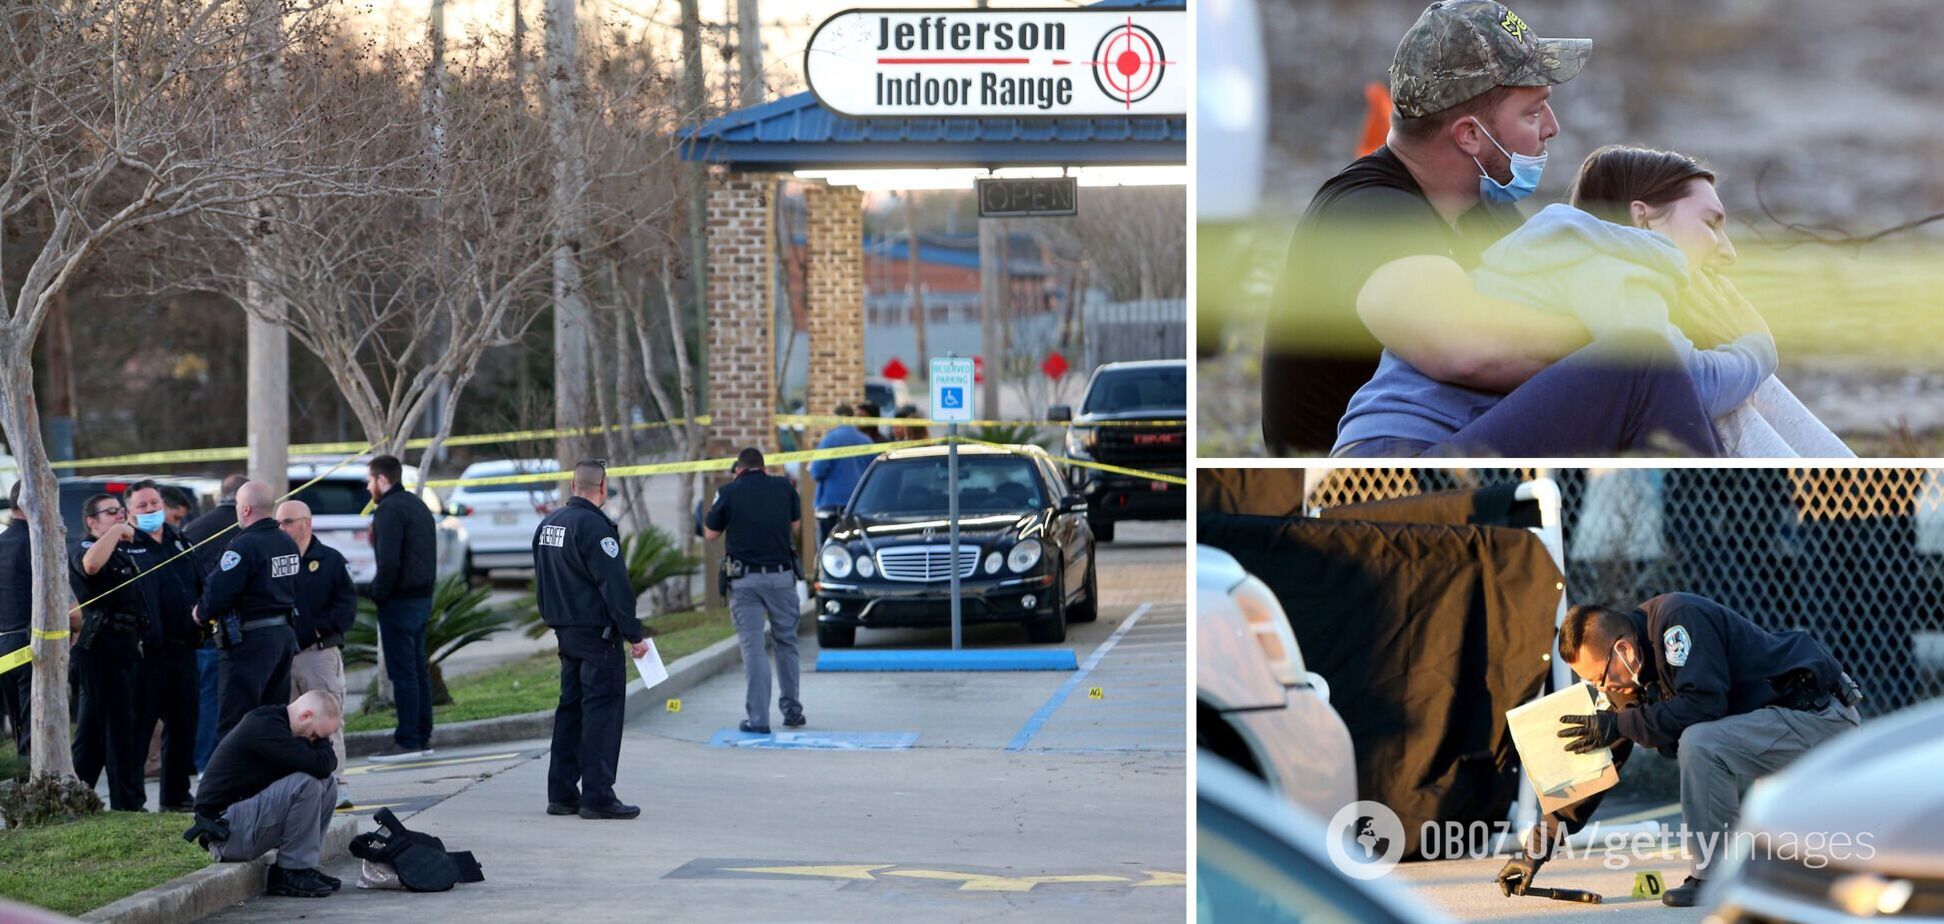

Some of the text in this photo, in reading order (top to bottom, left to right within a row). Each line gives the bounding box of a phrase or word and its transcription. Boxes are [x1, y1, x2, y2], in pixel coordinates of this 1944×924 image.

[877, 17, 1065, 50] Jefferson
[877, 72, 1072, 109] Indoor Range
[986, 182, 1072, 209] OPEN
[933, 365, 971, 374] RESERVED
[936, 375, 968, 385] PARKING
[1645, 874, 1660, 895] D
